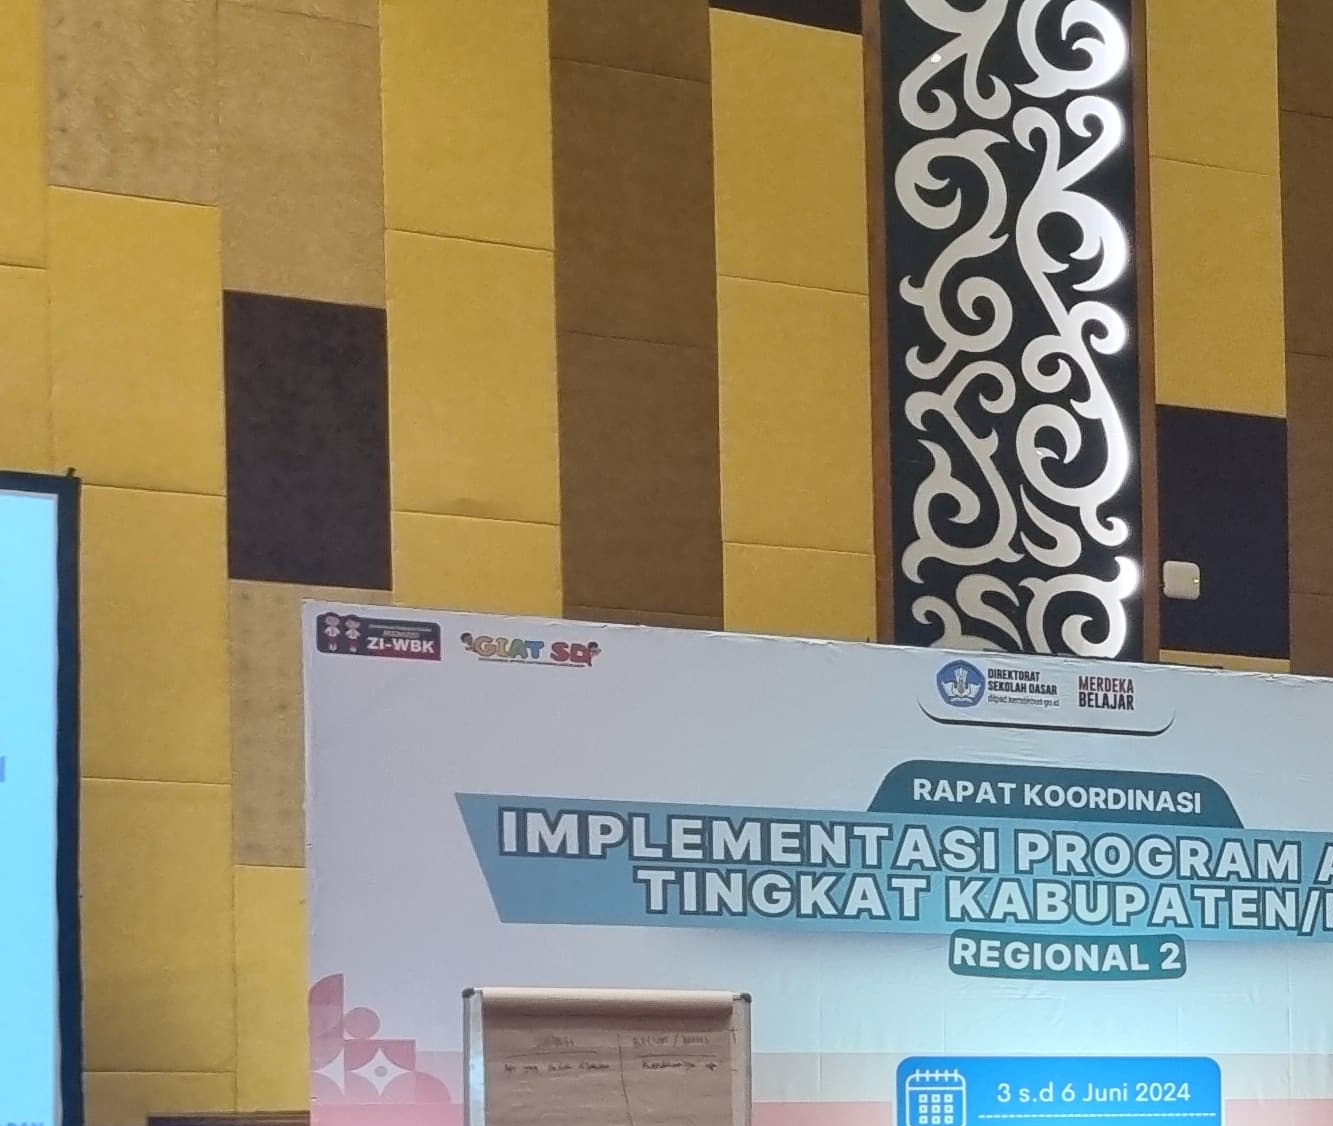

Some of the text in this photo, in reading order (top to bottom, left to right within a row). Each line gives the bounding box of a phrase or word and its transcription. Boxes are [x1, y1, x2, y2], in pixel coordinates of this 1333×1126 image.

[367, 637, 435, 654] ZI-WBK
[474, 635, 544, 659] GIAT
[550, 641, 590, 663] SD
[987, 668, 1040, 682] DIREKTORAT
[1078, 675, 1134, 694] MERDEKA
[987, 681, 1058, 696] SEKOLAH DASAR
[1078, 691, 1135, 711] BELAJAR
[913, 777, 1202, 814] RAPAT KOORDINASI
[500, 807, 1000, 873] IMPLEMENTASI
[1014, 829, 1301, 883] PROGRAM
[633, 866, 930, 921] TINGKAT
[952, 937, 1182, 972] REGIONAL 2
[996, 1081, 1191, 1103] 3 s.d 6 Juni 2024
